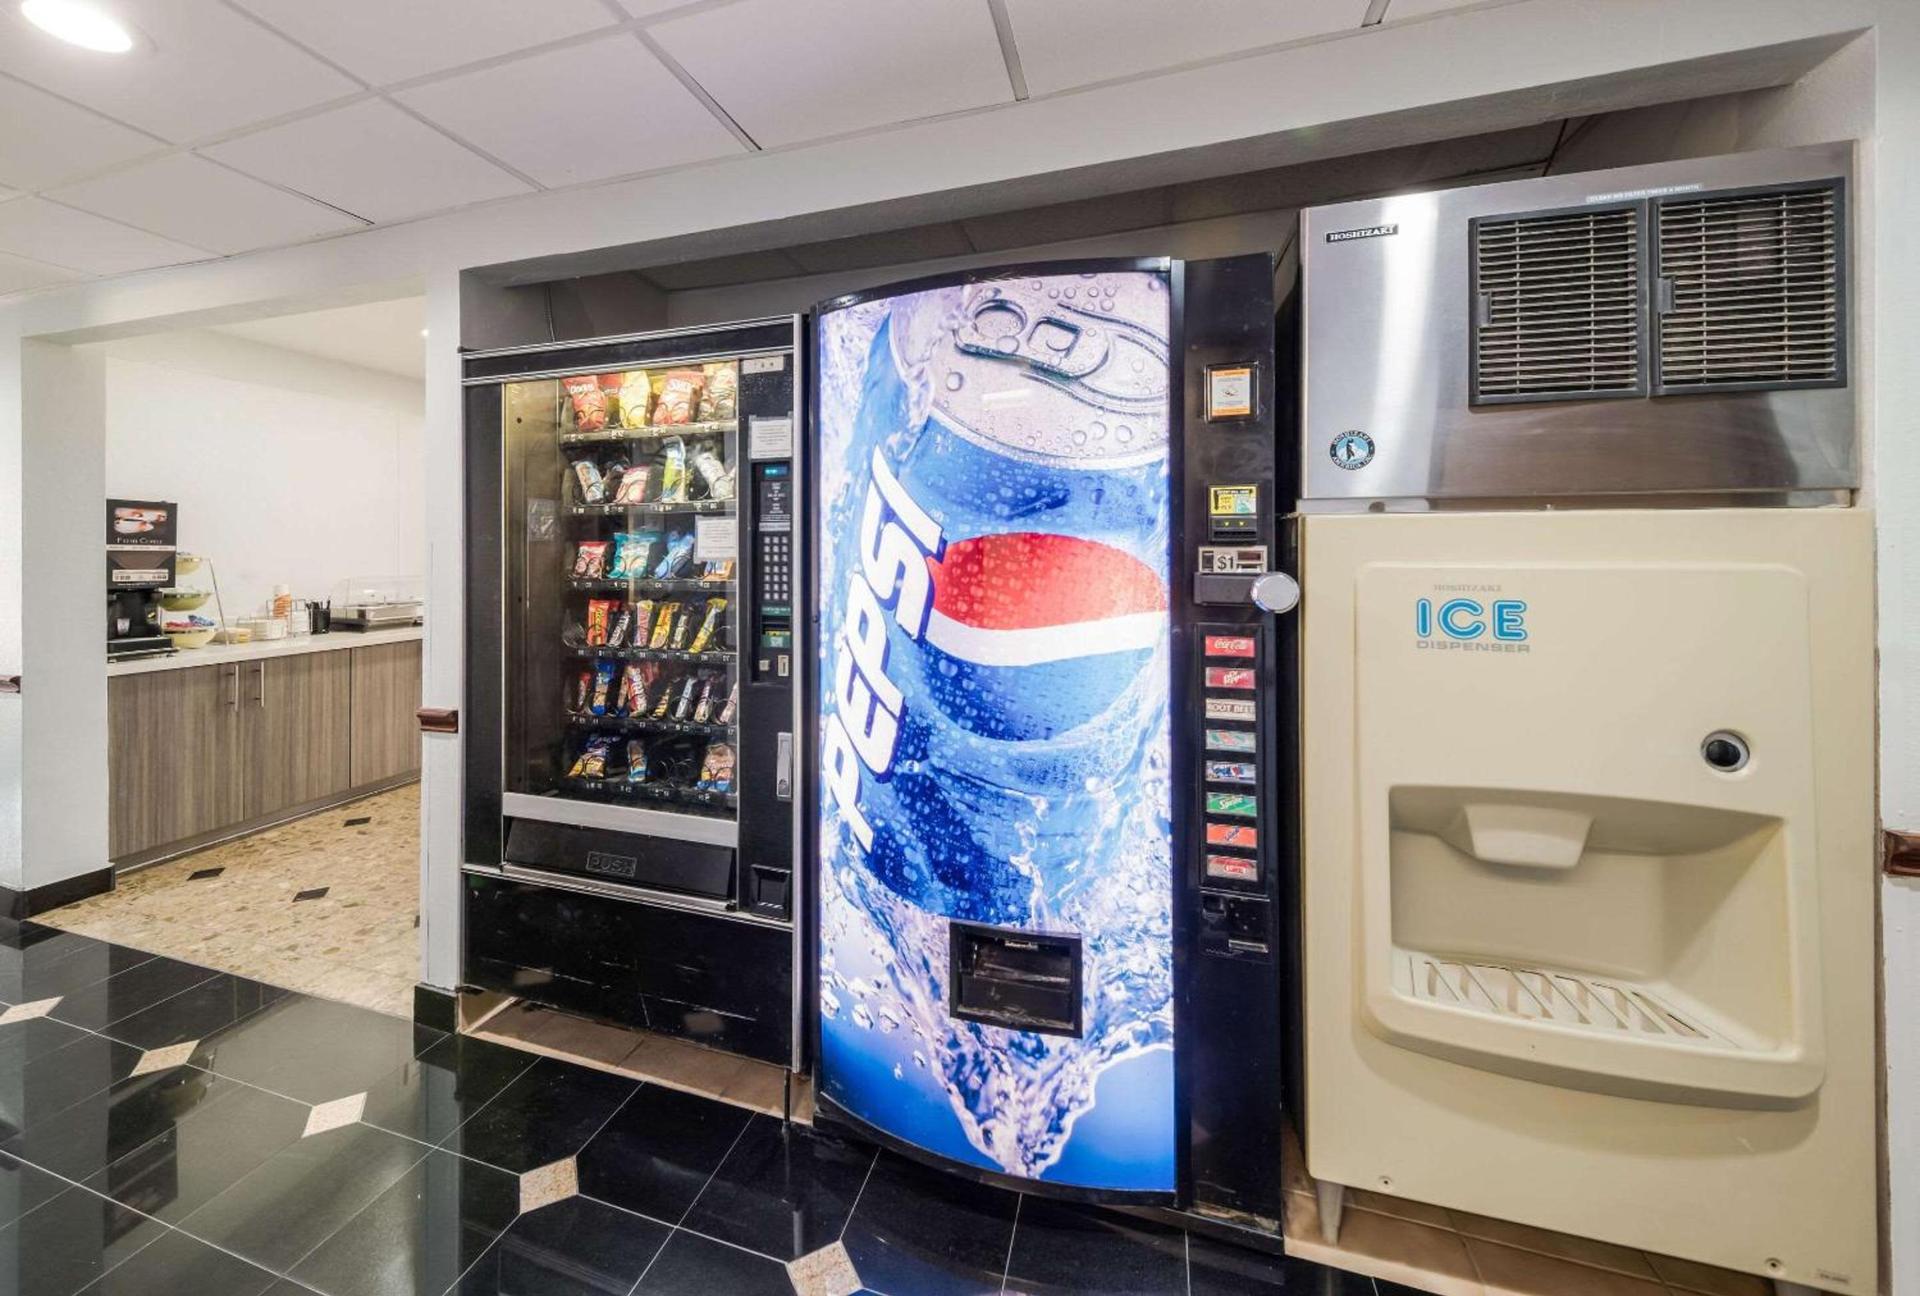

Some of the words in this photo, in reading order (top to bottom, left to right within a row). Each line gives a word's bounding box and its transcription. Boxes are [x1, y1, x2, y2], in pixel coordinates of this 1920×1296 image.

[1329, 226, 1395, 241] HOSHIZAKI
[1217, 555, 1234, 570] $1
[1416, 598, 1528, 641] ICE
[1416, 640, 1531, 654] DISPENSER
[591, 856, 635, 874] PUSH
